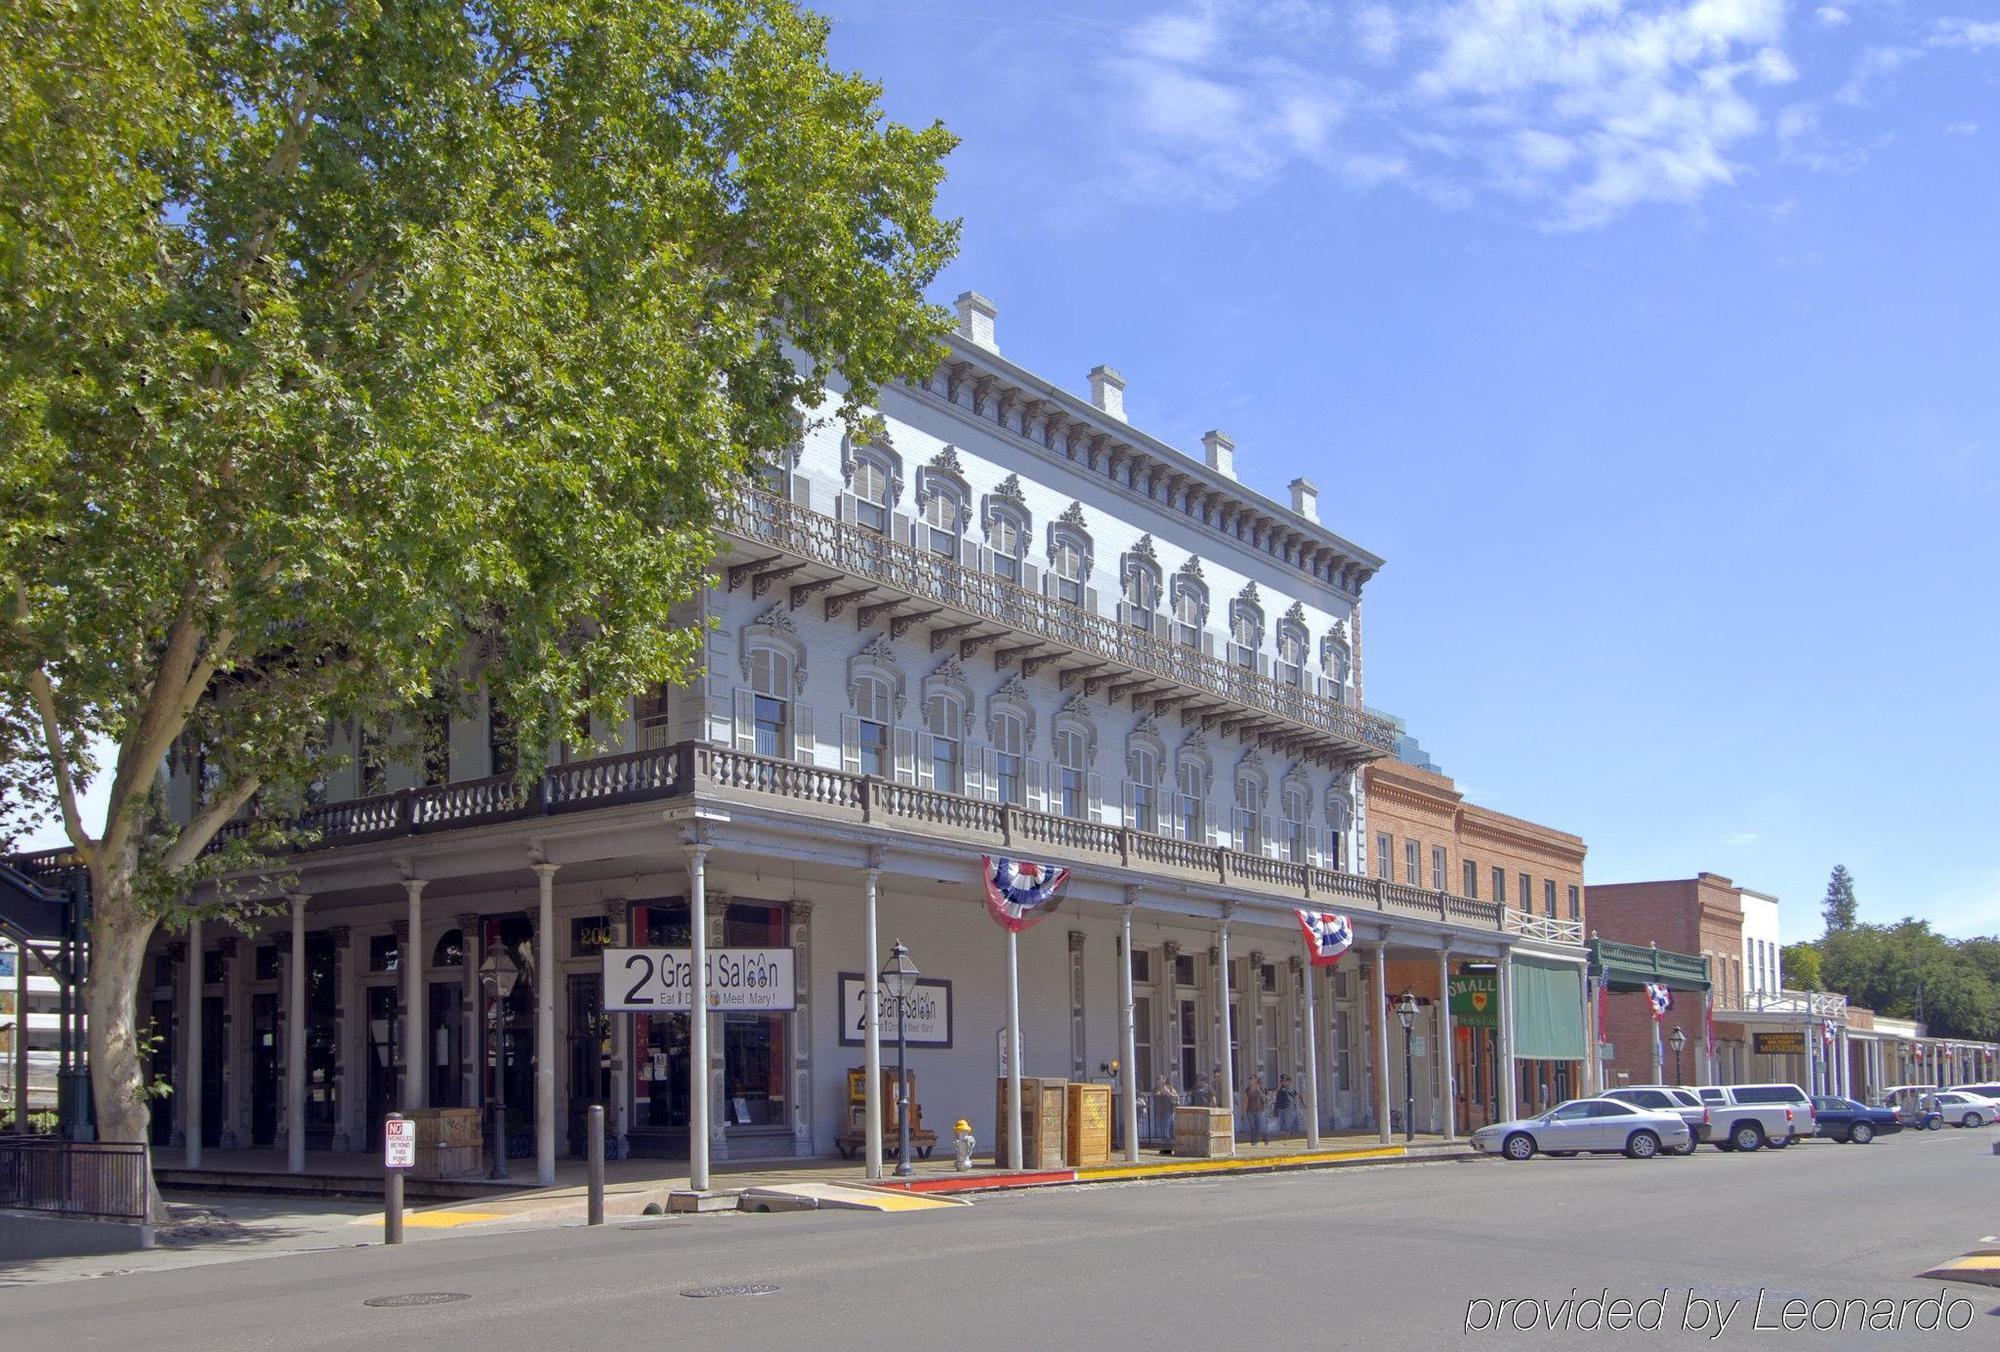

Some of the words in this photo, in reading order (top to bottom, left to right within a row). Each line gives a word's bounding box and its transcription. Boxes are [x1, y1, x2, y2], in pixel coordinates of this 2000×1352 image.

[623, 954, 654, 1005] 2
[660, 953, 712, 988] Grad
[718, 952, 778, 988] Saloon
[660, 992, 675, 1005] Eat
[723, 992, 745, 1005] Meet
[878, 990, 902, 1019] Gran
[388, 1122, 402, 1134] NO
